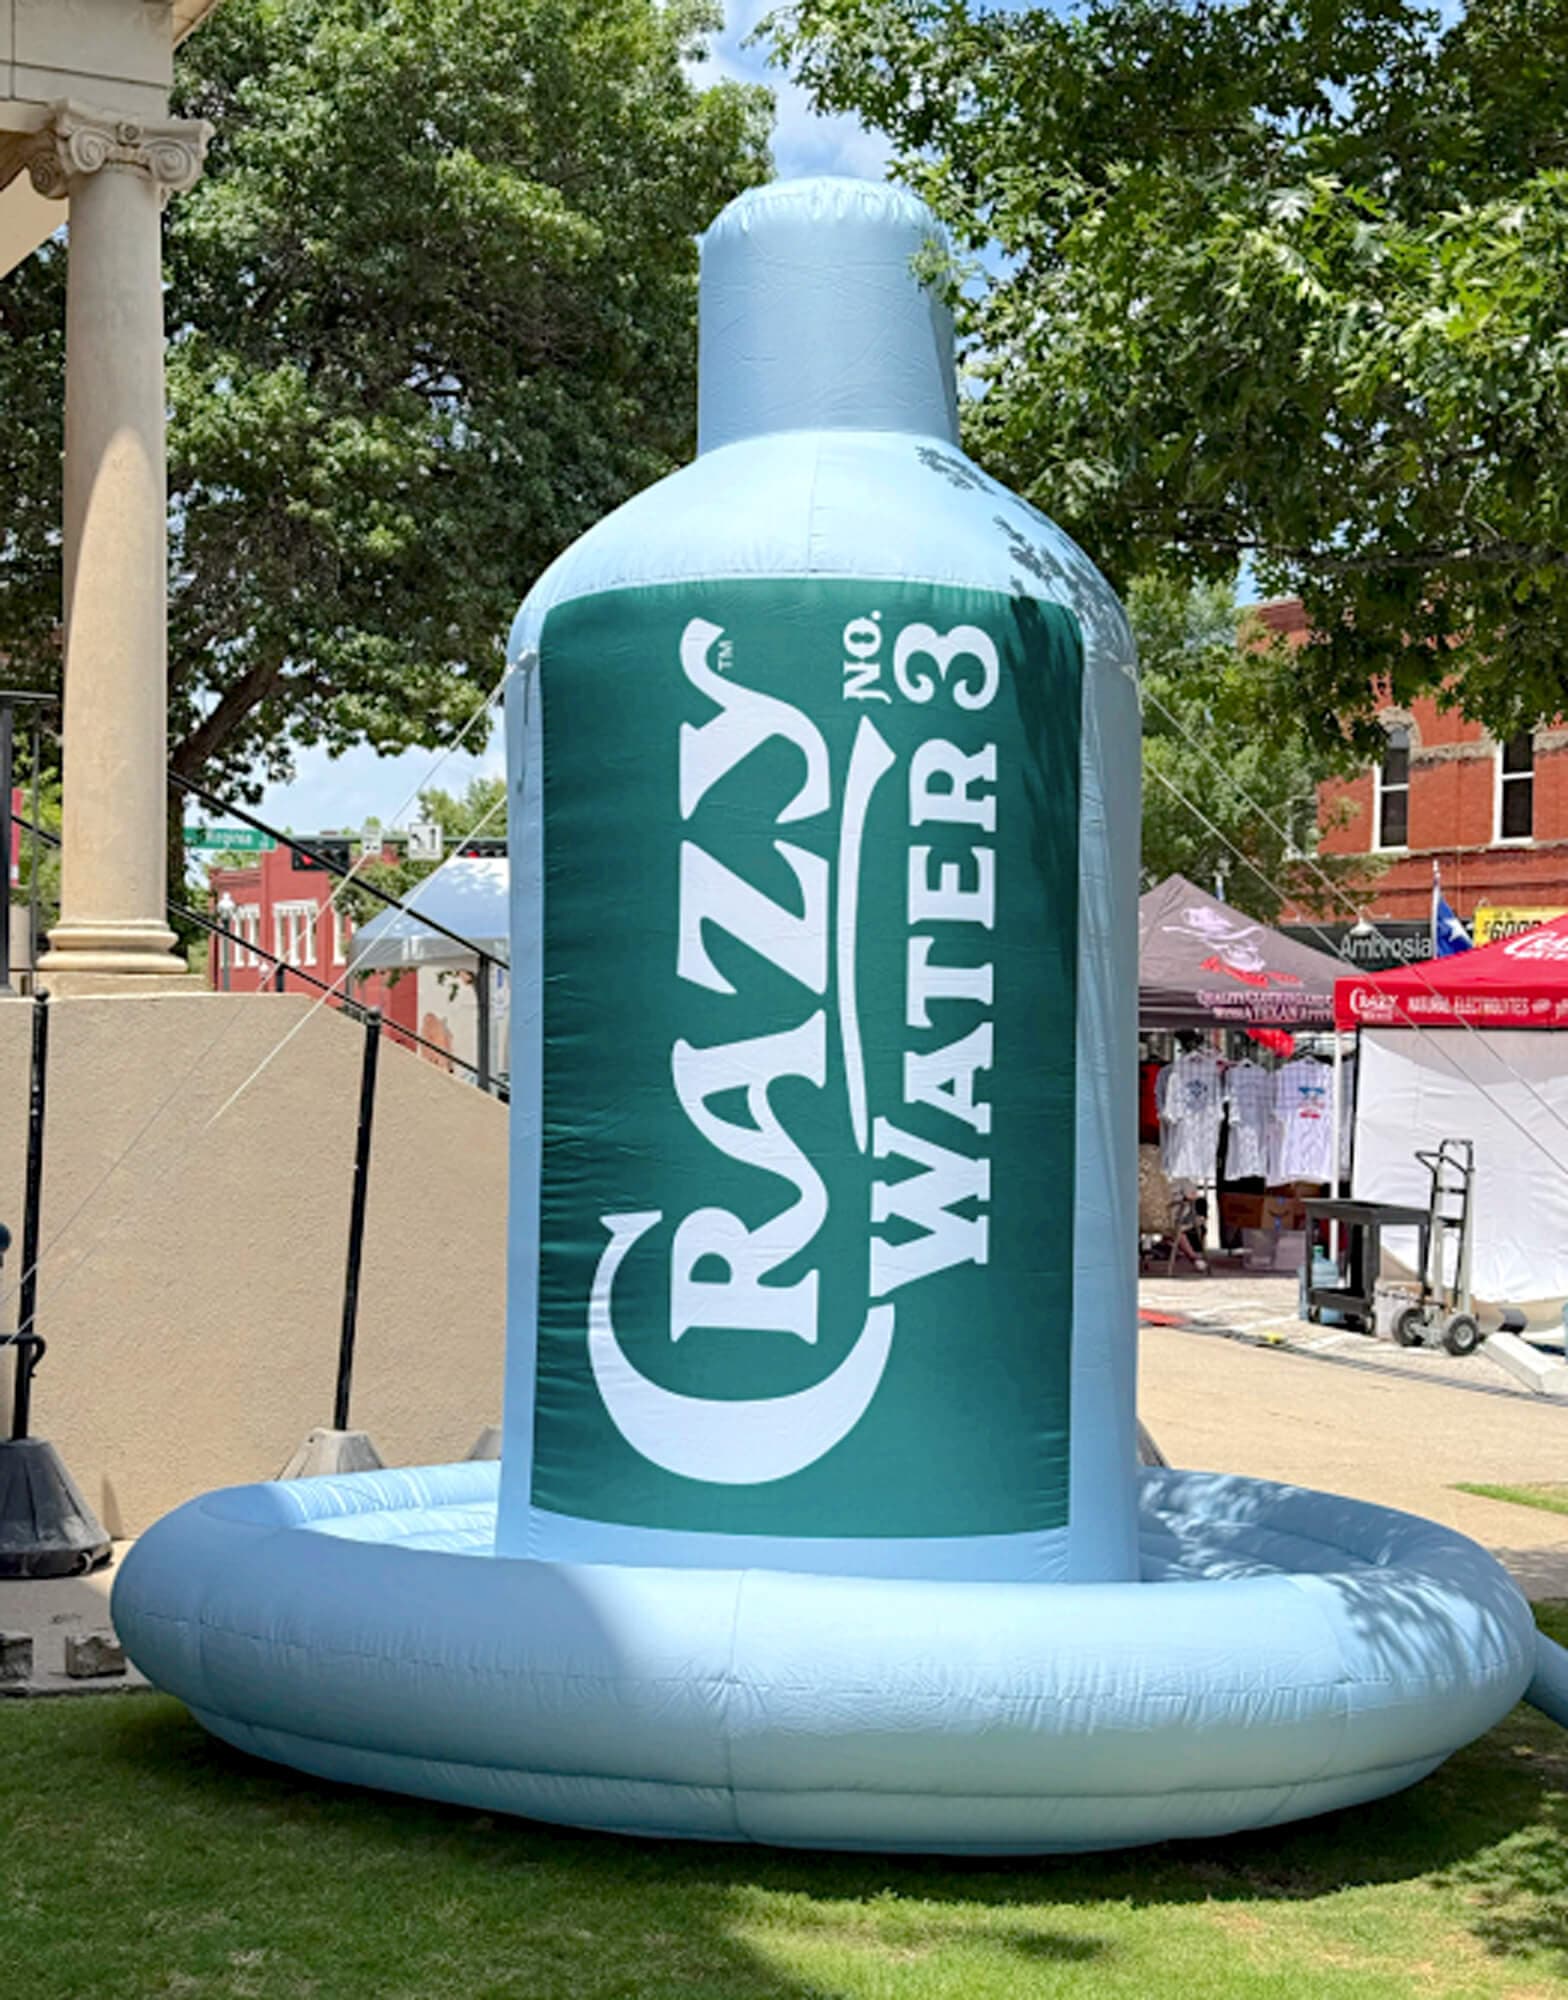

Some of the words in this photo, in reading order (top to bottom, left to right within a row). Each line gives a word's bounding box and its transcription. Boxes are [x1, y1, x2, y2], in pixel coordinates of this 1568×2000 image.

[717, 639, 733, 671] TM
[842, 610, 893, 704] NO.
[893, 623, 1000, 710] 3
[1340, 932, 1432, 958] Ambrosia
[587, 617, 896, 1485] CRAZY
[869, 738, 998, 1298] WATER
